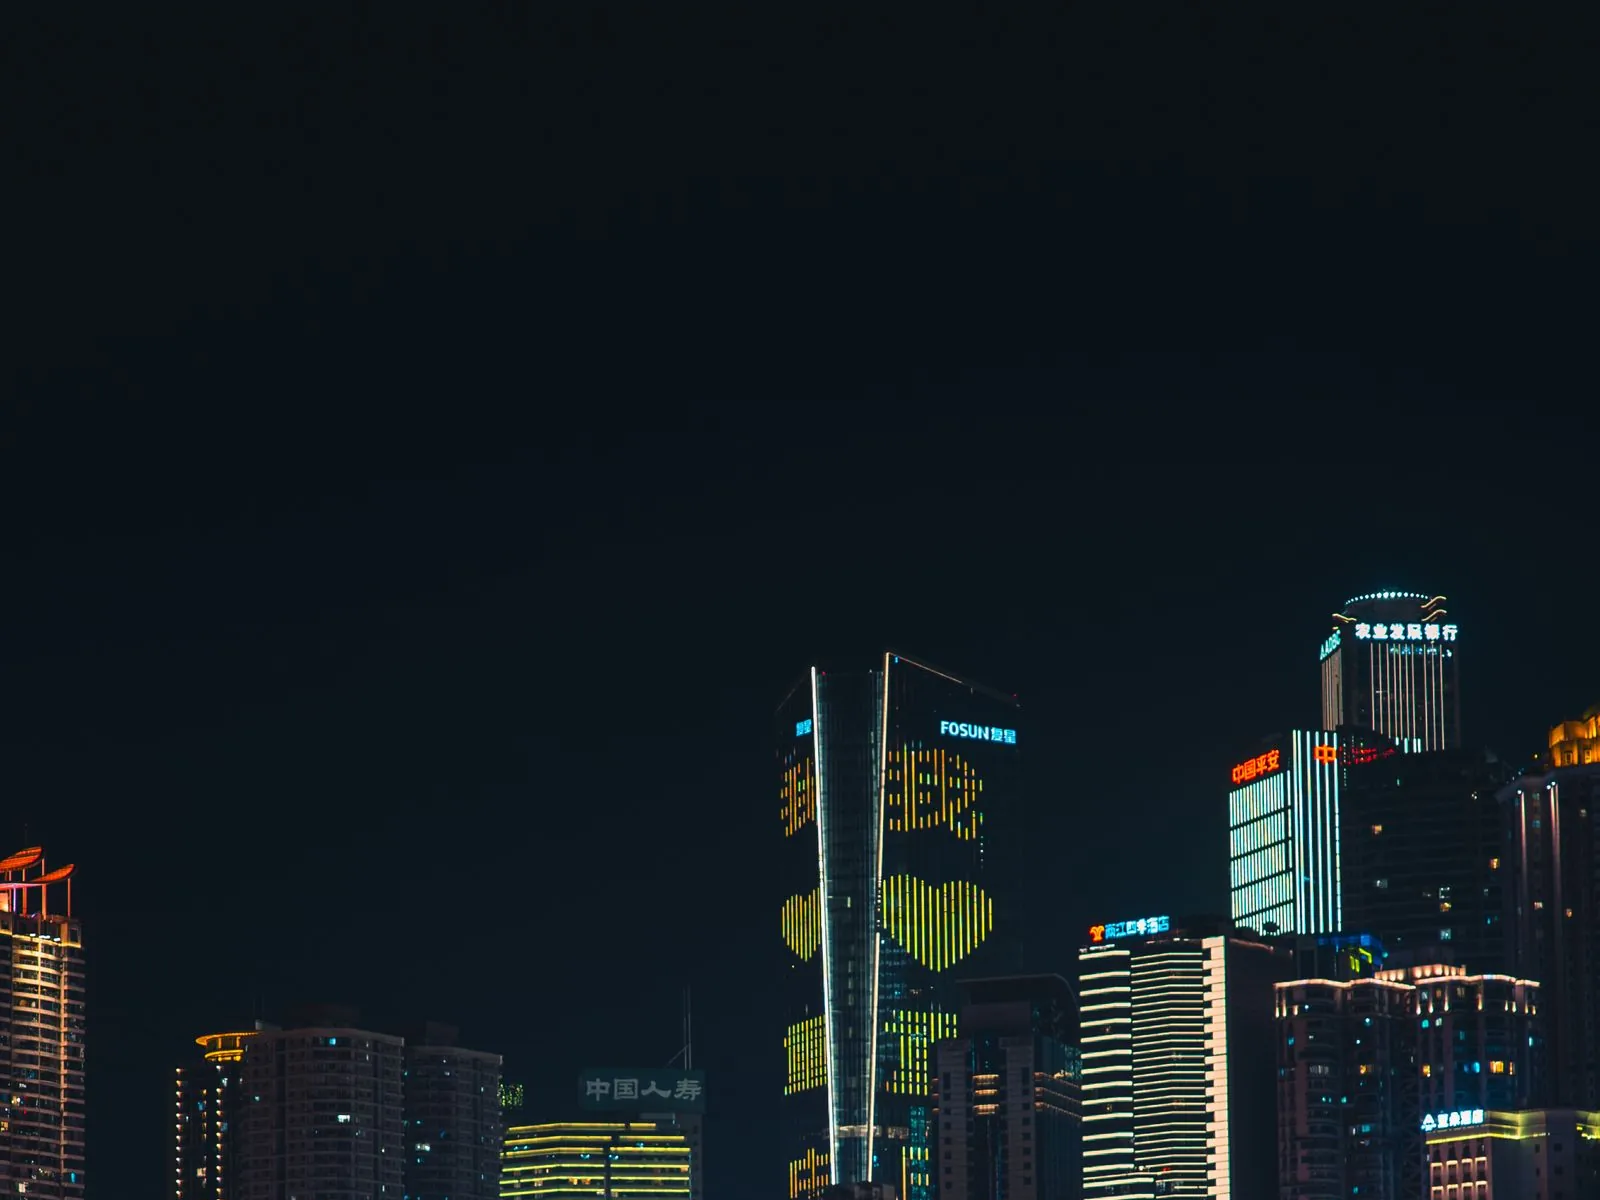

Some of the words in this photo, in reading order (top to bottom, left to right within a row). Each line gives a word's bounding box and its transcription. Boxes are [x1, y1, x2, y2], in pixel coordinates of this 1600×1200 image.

[1355, 622, 1459, 641] 农业发展银行
[940, 720, 990, 741] FOSUN
[1232, 749, 1280, 784] 中国平安
[586, 1078, 703, 1101] 中国人寿
